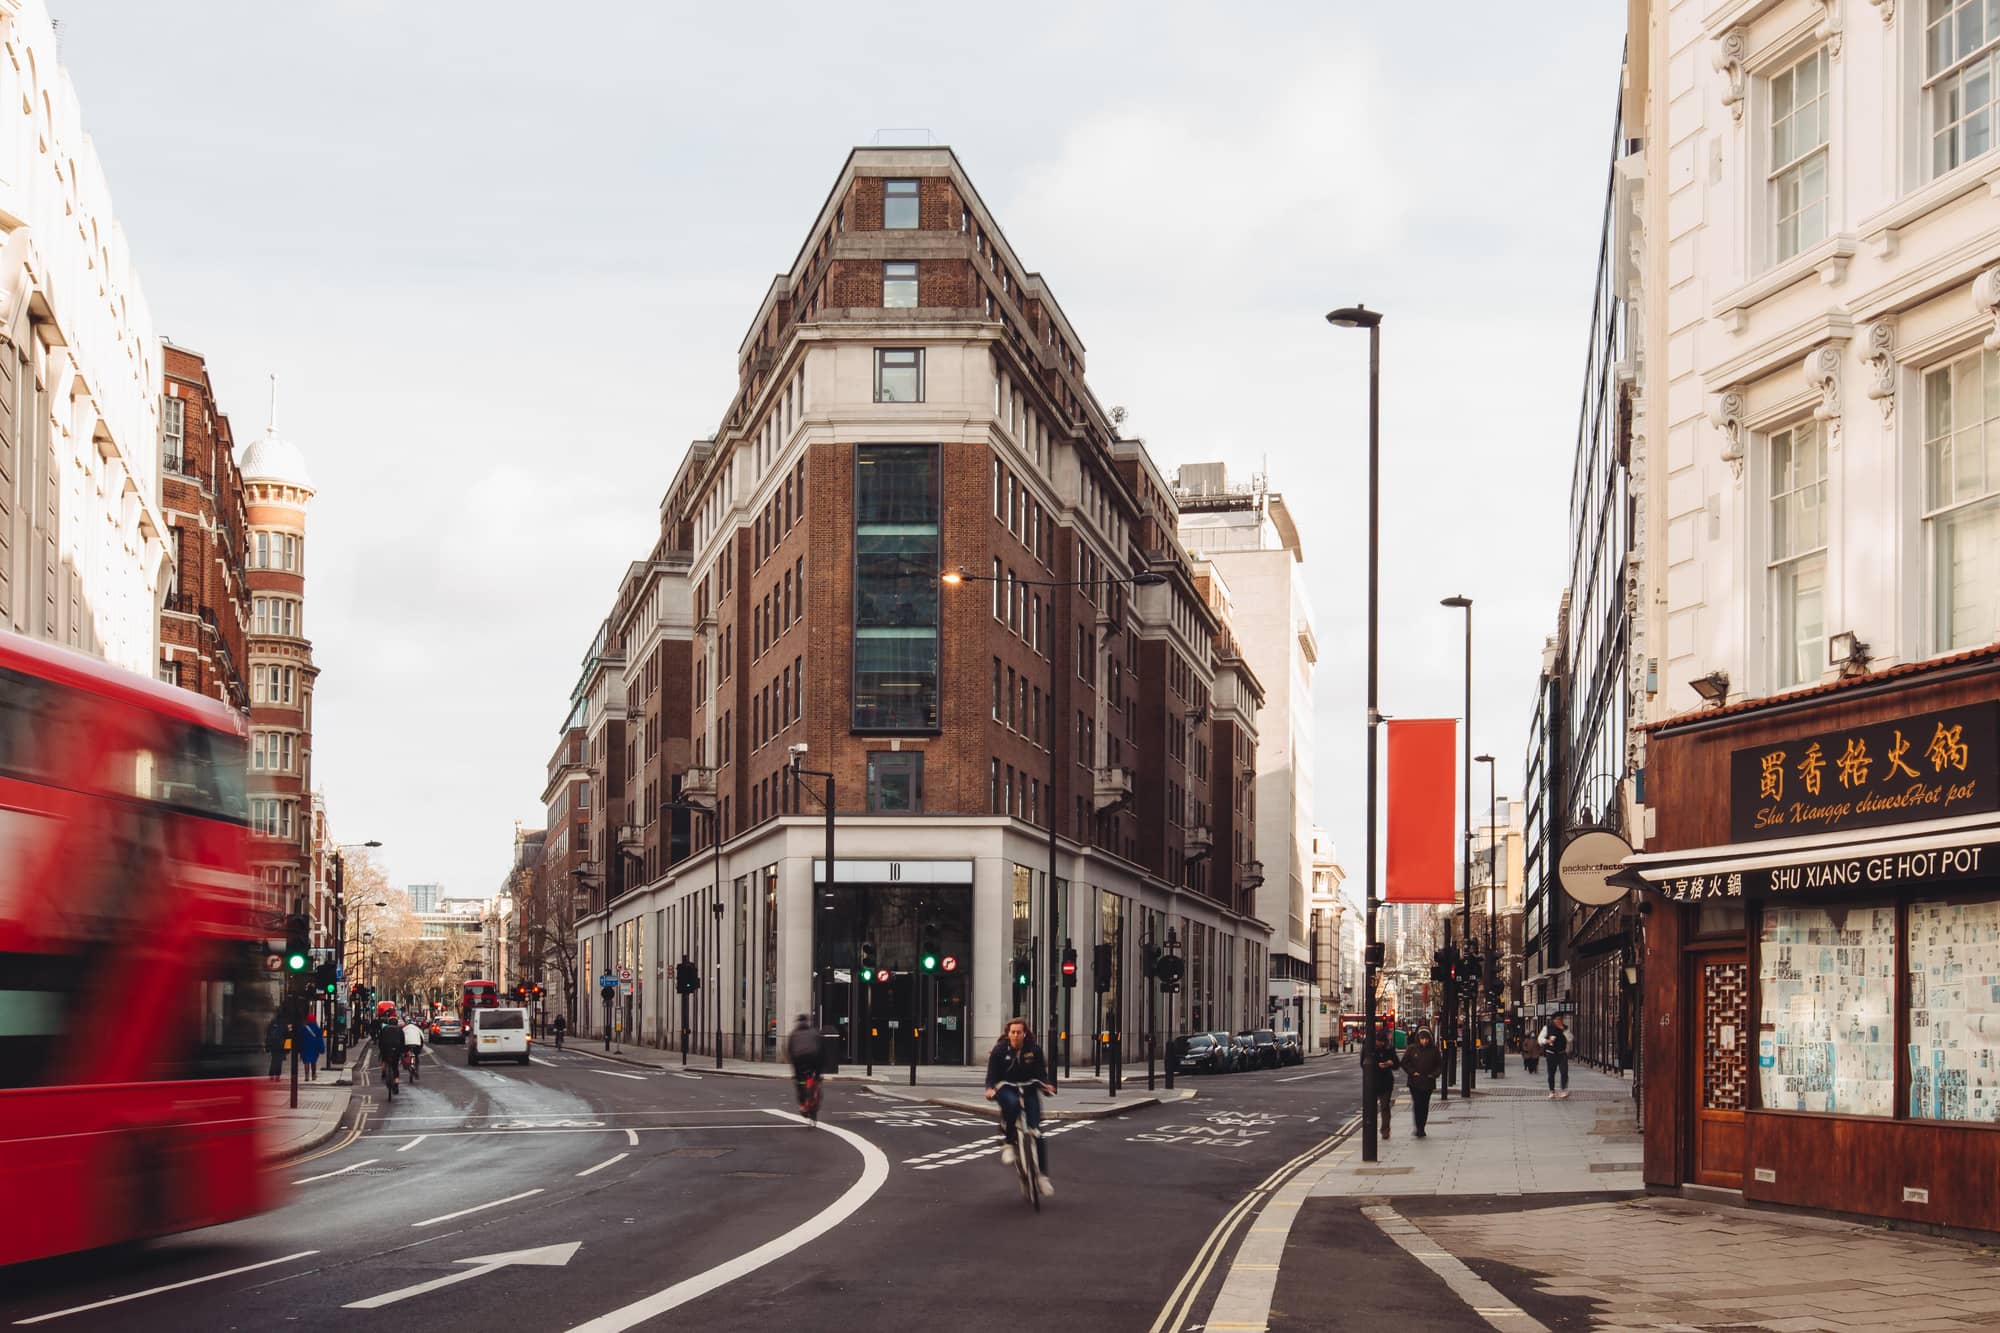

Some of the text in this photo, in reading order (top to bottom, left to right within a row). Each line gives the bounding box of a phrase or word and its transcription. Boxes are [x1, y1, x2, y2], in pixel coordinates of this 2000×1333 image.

[1754, 804, 1784, 829] Shu
[1790, 801, 1851, 824] Xiangge
[1944, 779, 1976, 807] pot
[1562, 863, 1628, 874] packshotfacto
[1770, 848, 1982, 891] SHU XIANG GE HOT POT
[1156, 1125, 1271, 1137] AND
[1125, 1133, 1255, 1147] BUS
